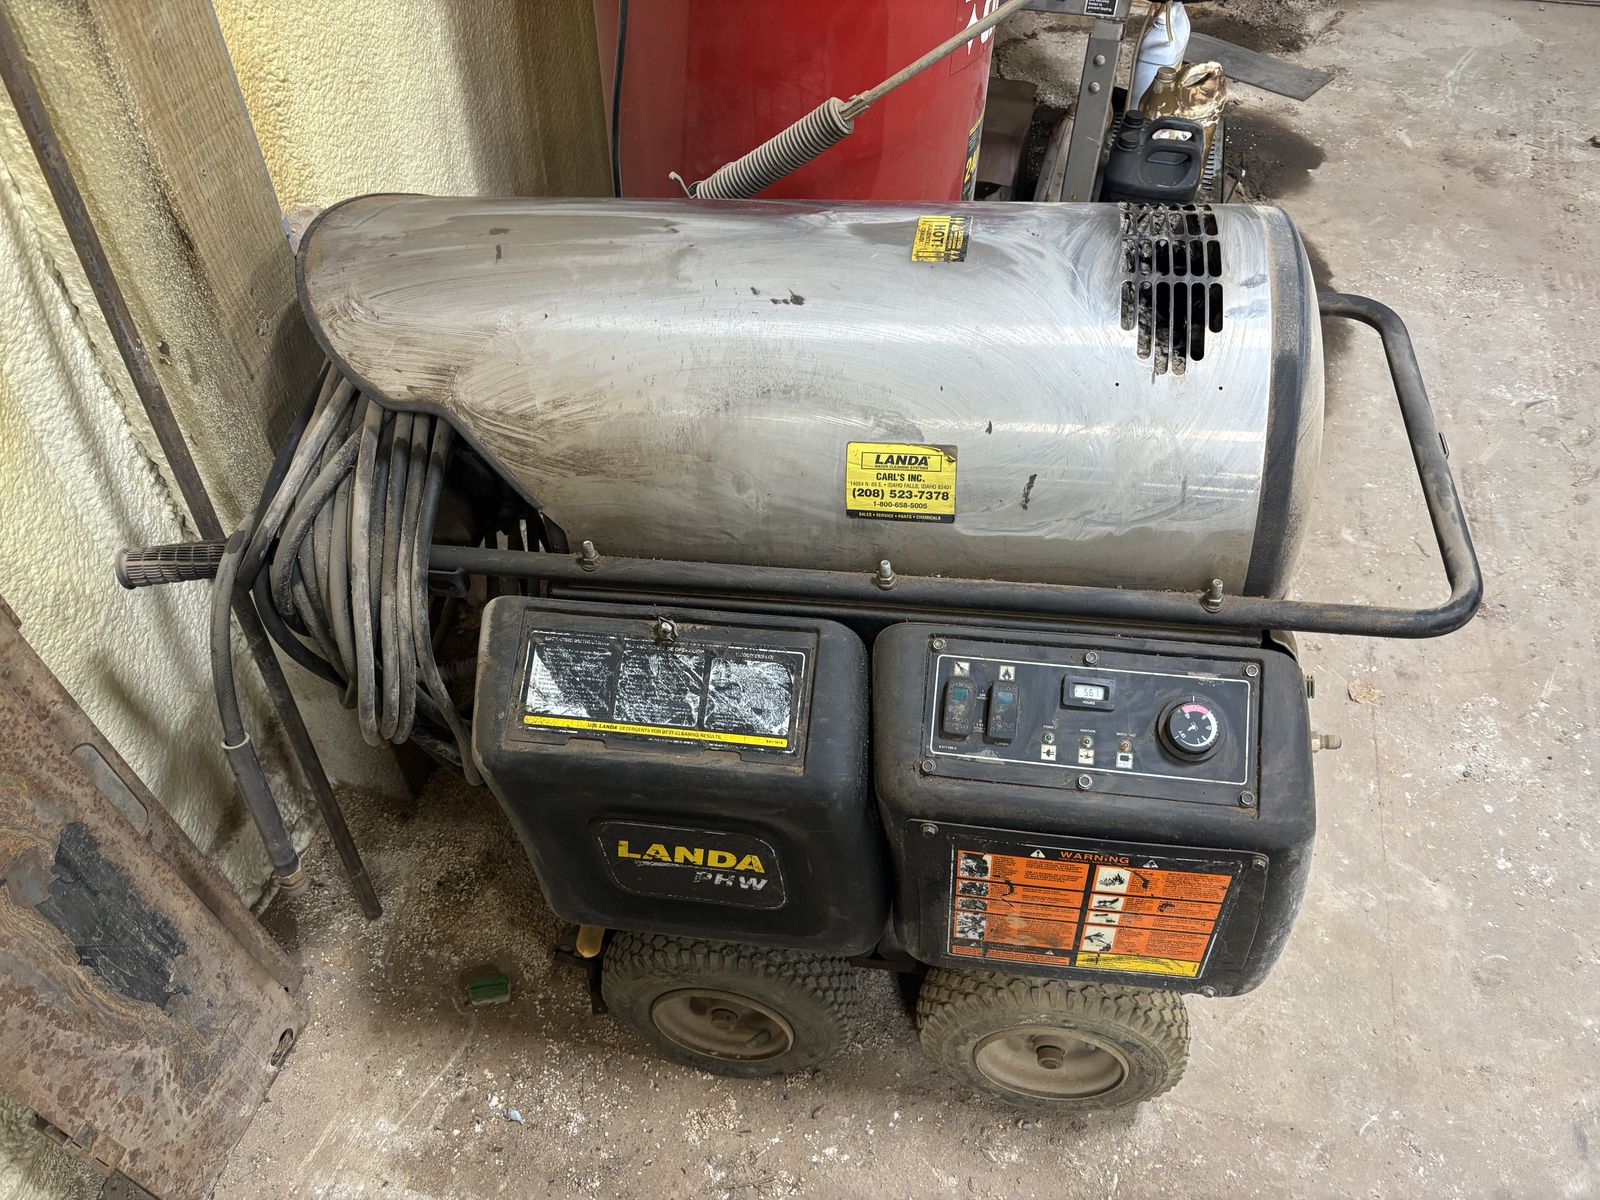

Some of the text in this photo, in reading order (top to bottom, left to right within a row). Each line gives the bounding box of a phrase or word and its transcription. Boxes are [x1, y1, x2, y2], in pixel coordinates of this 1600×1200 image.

[931, 224, 947, 247] HOT!
[875, 454, 928, 466] LANDA
[876, 473, 925, 482] CARL'S INC.
[852, 488, 949, 500] (208) 523-7378
[873, 501, 928, 509] 1-800-658-5005
[619, 725, 650, 733] DETERGENTS
[617, 840, 766, 874] LANDA
[1060, 851, 1129, 864] WARNING
[693, 871, 768, 891] PHW
